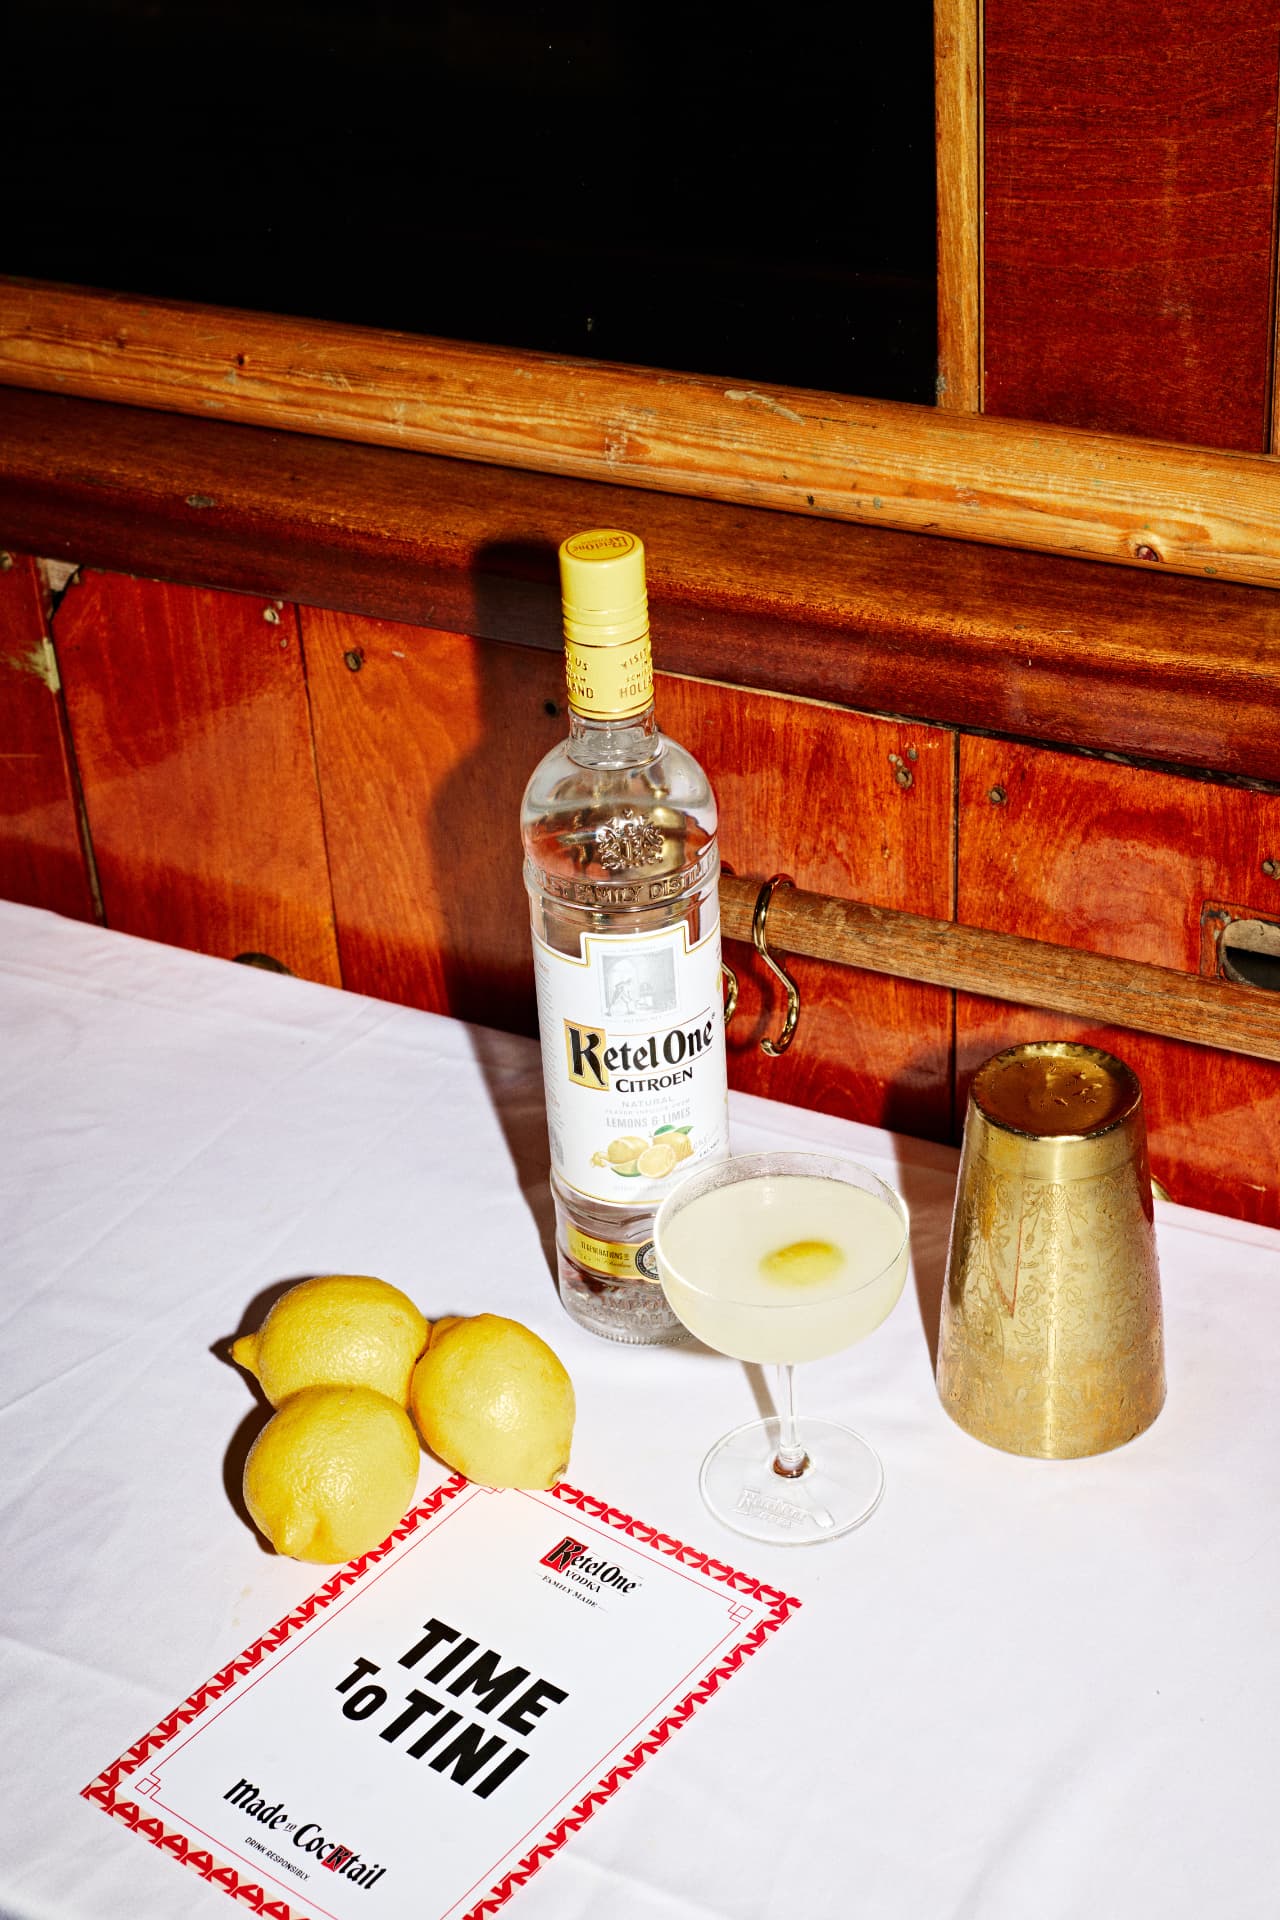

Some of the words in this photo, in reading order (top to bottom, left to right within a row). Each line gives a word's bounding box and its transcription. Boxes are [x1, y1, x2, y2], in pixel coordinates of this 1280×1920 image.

[620, 674, 652, 698] HOLLA
[615, 1066, 694, 1093] CITROEN
[606, 1116, 648, 1128] LEMONS
[663, 1106, 690, 1124] LIMES
[542, 1575, 572, 1595] FAMILY
[573, 1590, 598, 1608] MADE
[564, 1569, 601, 1593] VODKA
[397, 1617, 570, 1737] TIME
[378, 1688, 530, 1800] TINI
[245, 1836, 266, 1854] DRINK
[266, 1850, 311, 1882] RESPONSIBLY
